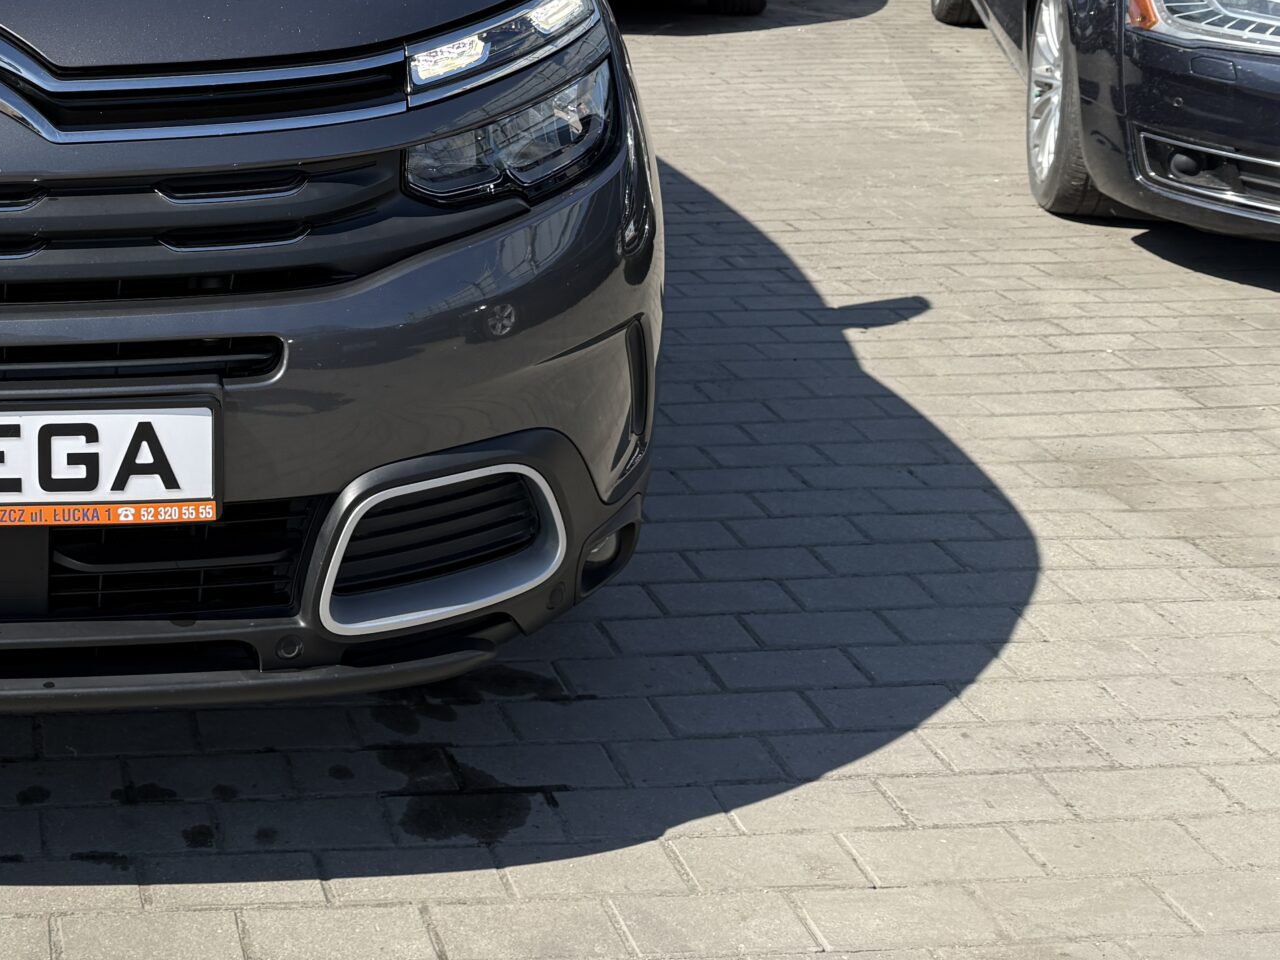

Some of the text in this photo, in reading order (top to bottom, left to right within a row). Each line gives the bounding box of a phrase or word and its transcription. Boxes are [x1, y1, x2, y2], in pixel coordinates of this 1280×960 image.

[30, 509, 47, 523] ul.
[53, 508, 99, 522] ŁUCKA
[105, 508, 112, 521] 1
[140, 506, 154, 520] 52
[157, 506, 179, 520] 320
[182, 505, 196, 519] 55
[198, 505, 213, 519] 55
